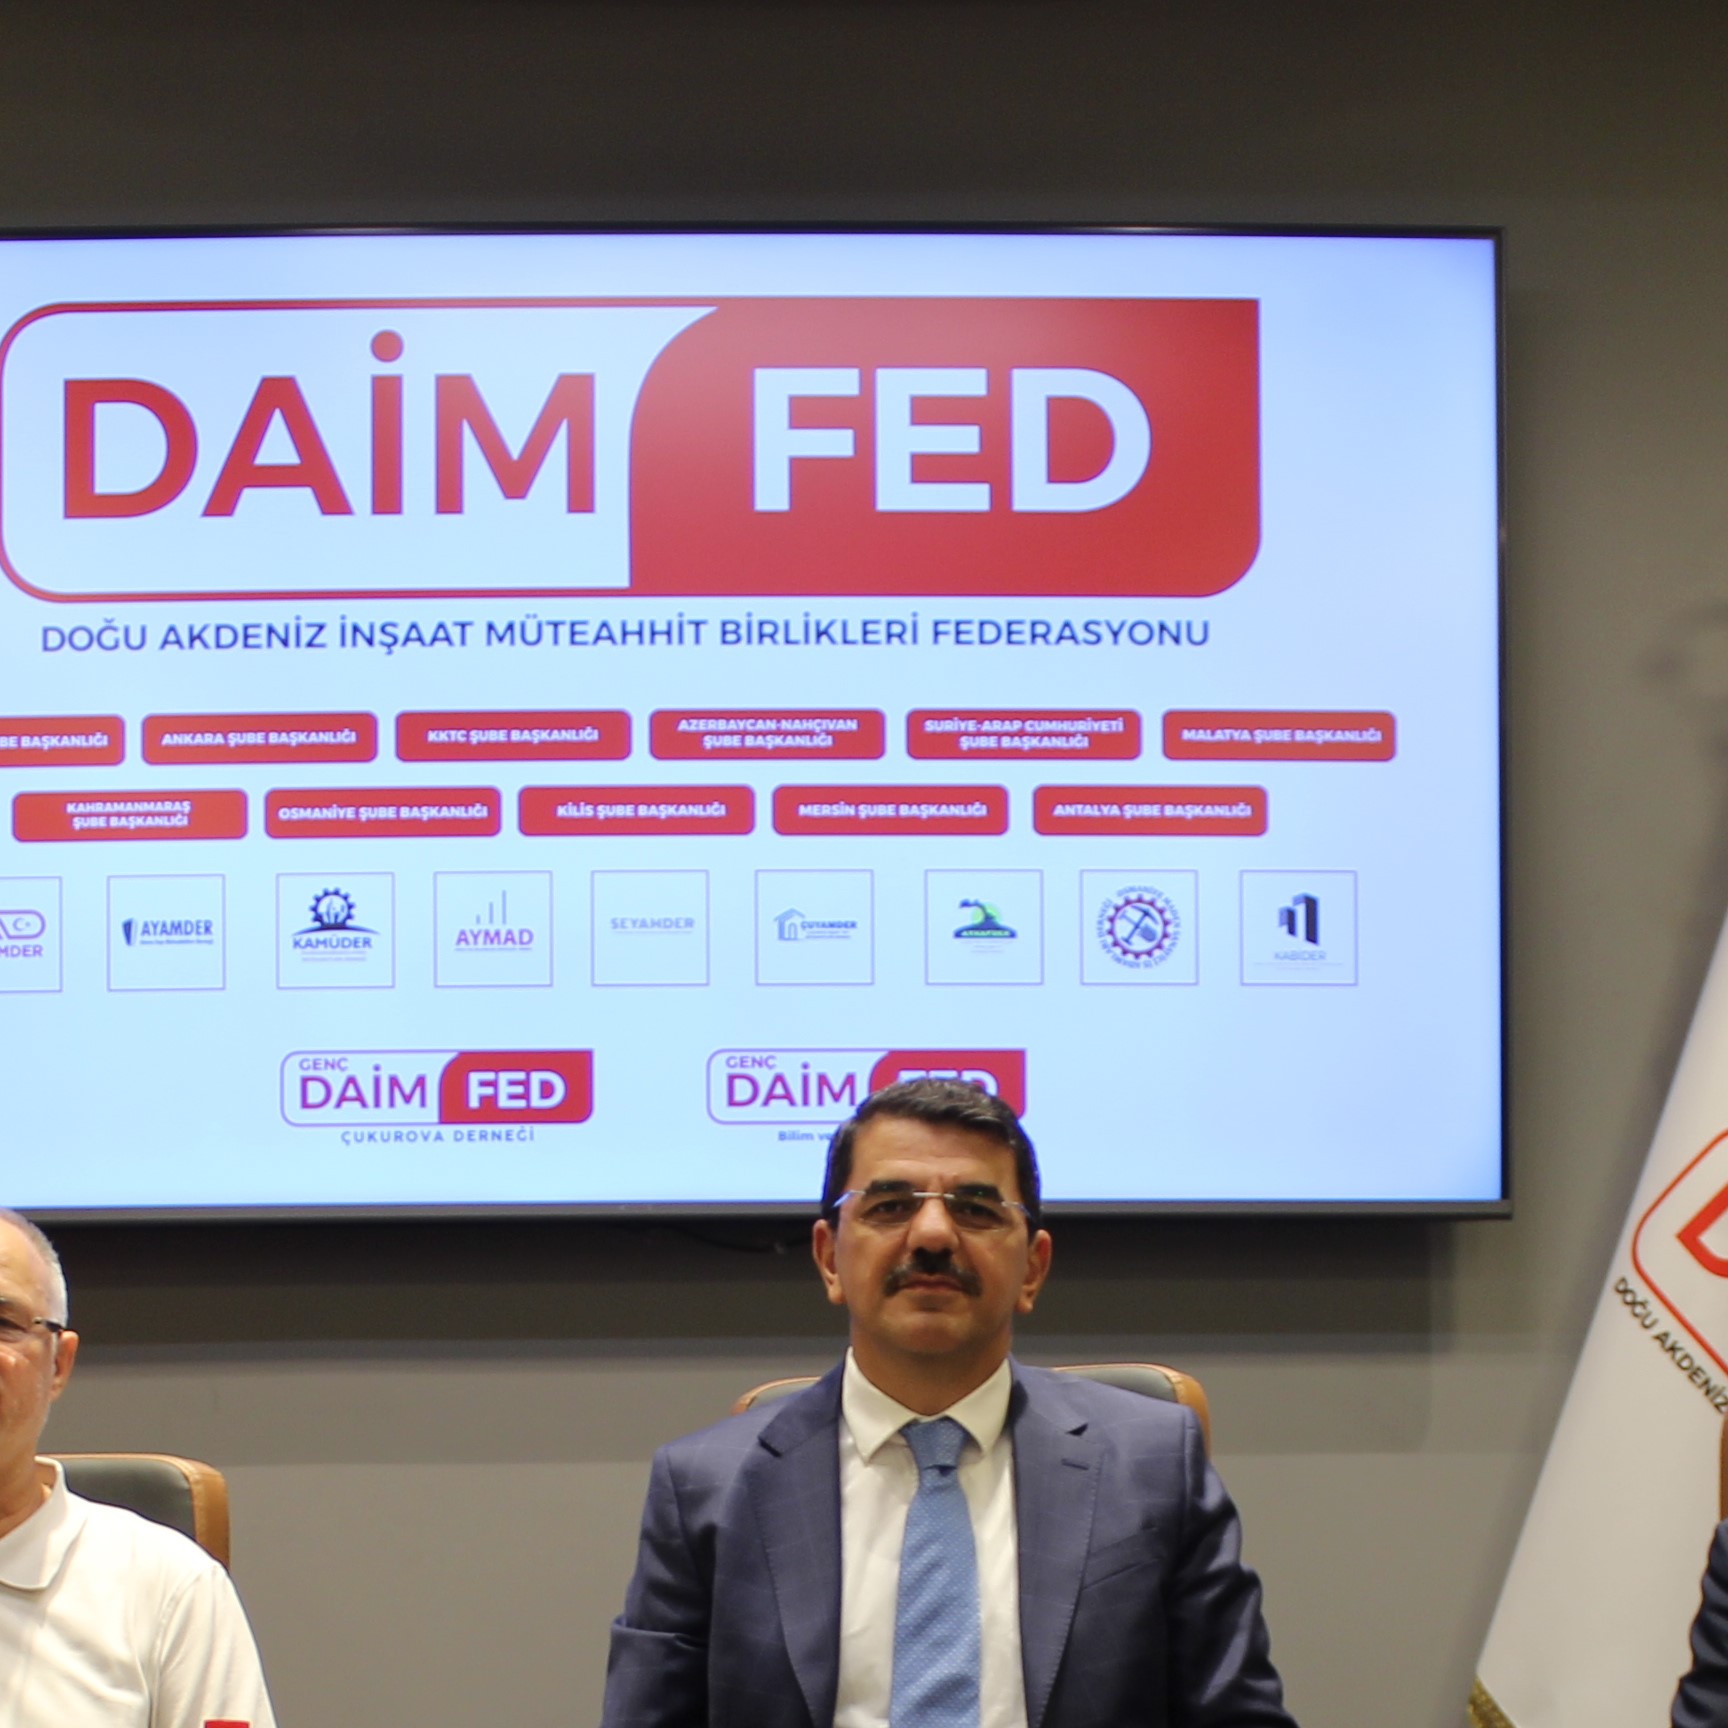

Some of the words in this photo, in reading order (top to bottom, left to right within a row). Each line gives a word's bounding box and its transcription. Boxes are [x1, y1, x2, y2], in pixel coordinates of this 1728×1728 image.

[63, 330, 595, 519] DAİM
[753, 368, 1150, 511] FED
[43, 621, 145, 651] DOĞU
[160, 616, 325, 649] AKDENİZ
[341, 616, 472, 654] İNŞAAT
[487, 613, 707, 645] MÜTEAHHİT
[721, 613, 917, 644] BİRLİKLERİ
[933, 620, 1208, 645] FEDERASYONU
[1024, 718, 1123, 732] CUMHURİYETİ
[21, 733, 108, 750] BAŞKANLIĞI
[162, 733, 225, 745] ANKARA
[228, 733, 265, 747] ŞUBE
[268, 729, 356, 746] BAŞKANLIĞI
[428, 730, 466, 742] KKTC
[470, 730, 508, 744] ŞUBE
[511, 727, 598, 743] BAŞKANLIĞI
[704, 735, 741, 749] ŞUBE
[744, 731, 832, 749] BAŞKANLIĞI
[960, 736, 998, 750] ŞUBE
[1001, 734, 1088, 750] BAŞKANLIĞI
[1182, 730, 1251, 741] MALATYA
[1254, 730, 1292, 743] ŞUBE
[1294, 728, 1381, 743] BAŞKANLIĞI
[67, 801, 191, 815] KAHRAMANMARAŞ
[279, 805, 355, 820] OSMANİYE
[359, 807, 397, 821] ŞUBE
[400, 804, 487, 820] BAŞKANLIĞI
[557, 802, 594, 817] KİLİS
[597, 805, 635, 819] ŞUBE
[638, 802, 725, 818] BAŞKANLIĞI
[799, 802, 855, 816] MERSİN
[858, 805, 896, 818] ŞUBE
[899, 802, 987, 818] BAŞKANLIĞI
[1054, 805, 1121, 816] ANTALYA
[1123, 805, 1161, 818] ŞUBE
[1164, 803, 1251, 819] BAŞKANLIĞI
[73, 815, 108, 830] ŞUBE
[109, 813, 189, 830] BAŞKANLIĞI
[140, 920, 214, 936] AYAMDER
[292, 934, 372, 949] KAMÜDER
[455, 928, 534, 947] AYMAD
[298, 1057, 348, 1072] GENÇ
[725, 1055, 777, 1070] GENÇ
[300, 1063, 427, 1109] DAİM
[467, 1070, 567, 1110] FED
[726, 1061, 856, 1107] DAİM
[340, 1130, 445, 1146] ÇUKUROVA
[453, 1125, 535, 1142] DERNEĞİ
[1614, 1276, 1660, 1330] DOĞU
